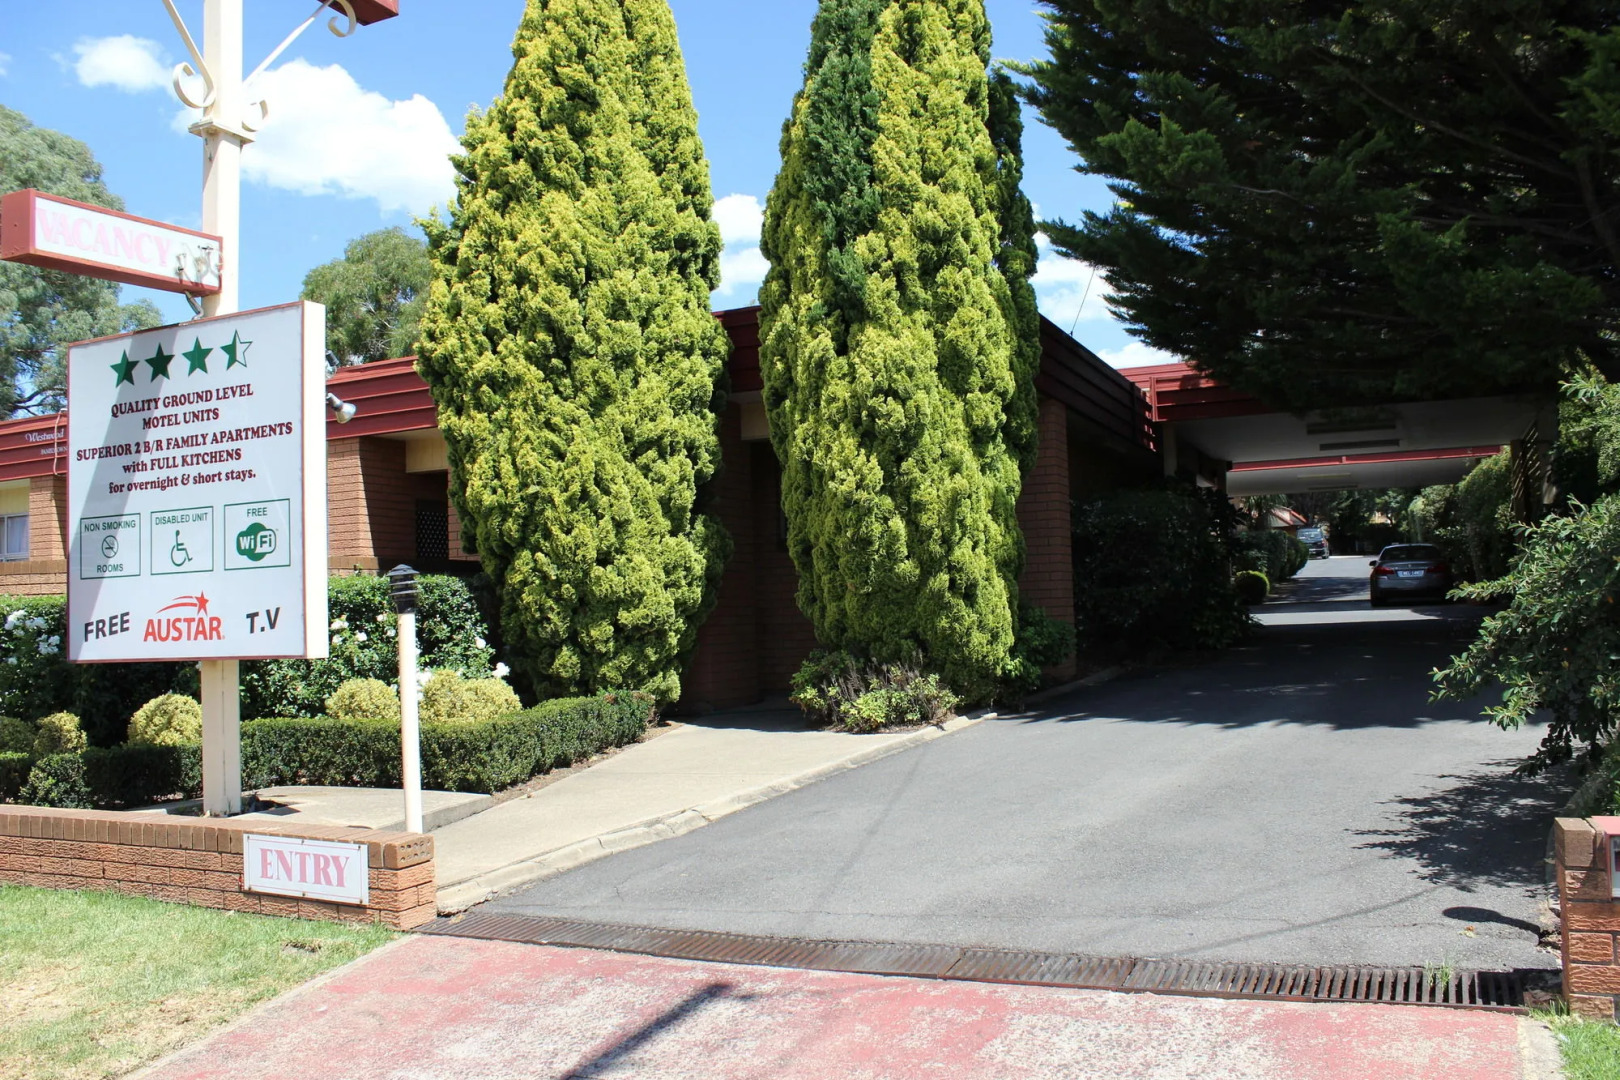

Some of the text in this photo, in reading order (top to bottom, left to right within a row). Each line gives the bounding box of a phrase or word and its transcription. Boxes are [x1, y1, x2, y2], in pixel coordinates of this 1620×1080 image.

[36, 208, 173, 267] VACANCY
[111, 383, 253, 418] QUALITY GROUND LEVEL
[142, 408, 219, 430] MOTEL UNITS
[25, 428, 64, 442] Westwod
[76, 443, 132, 461] SUPERIOR
[134, 442, 141, 454] 2
[143, 439, 163, 455] B/R
[166, 433, 209, 450] FAMILY
[210, 421, 293, 445] APARTMENTS
[122, 448, 242, 473] with FULL KITCHENS
[108, 469, 256, 494] for overnight & short stays.
[155, 512, 208, 525] DISABLED UNIT
[246, 507, 267, 517] FREE
[84, 520, 136, 532] NON SMOKING
[96, 563, 124, 573] ROOMS
[84, 606, 281, 642] FREE AUSTAR T.V
[259, 848, 350, 887] ENTRY
